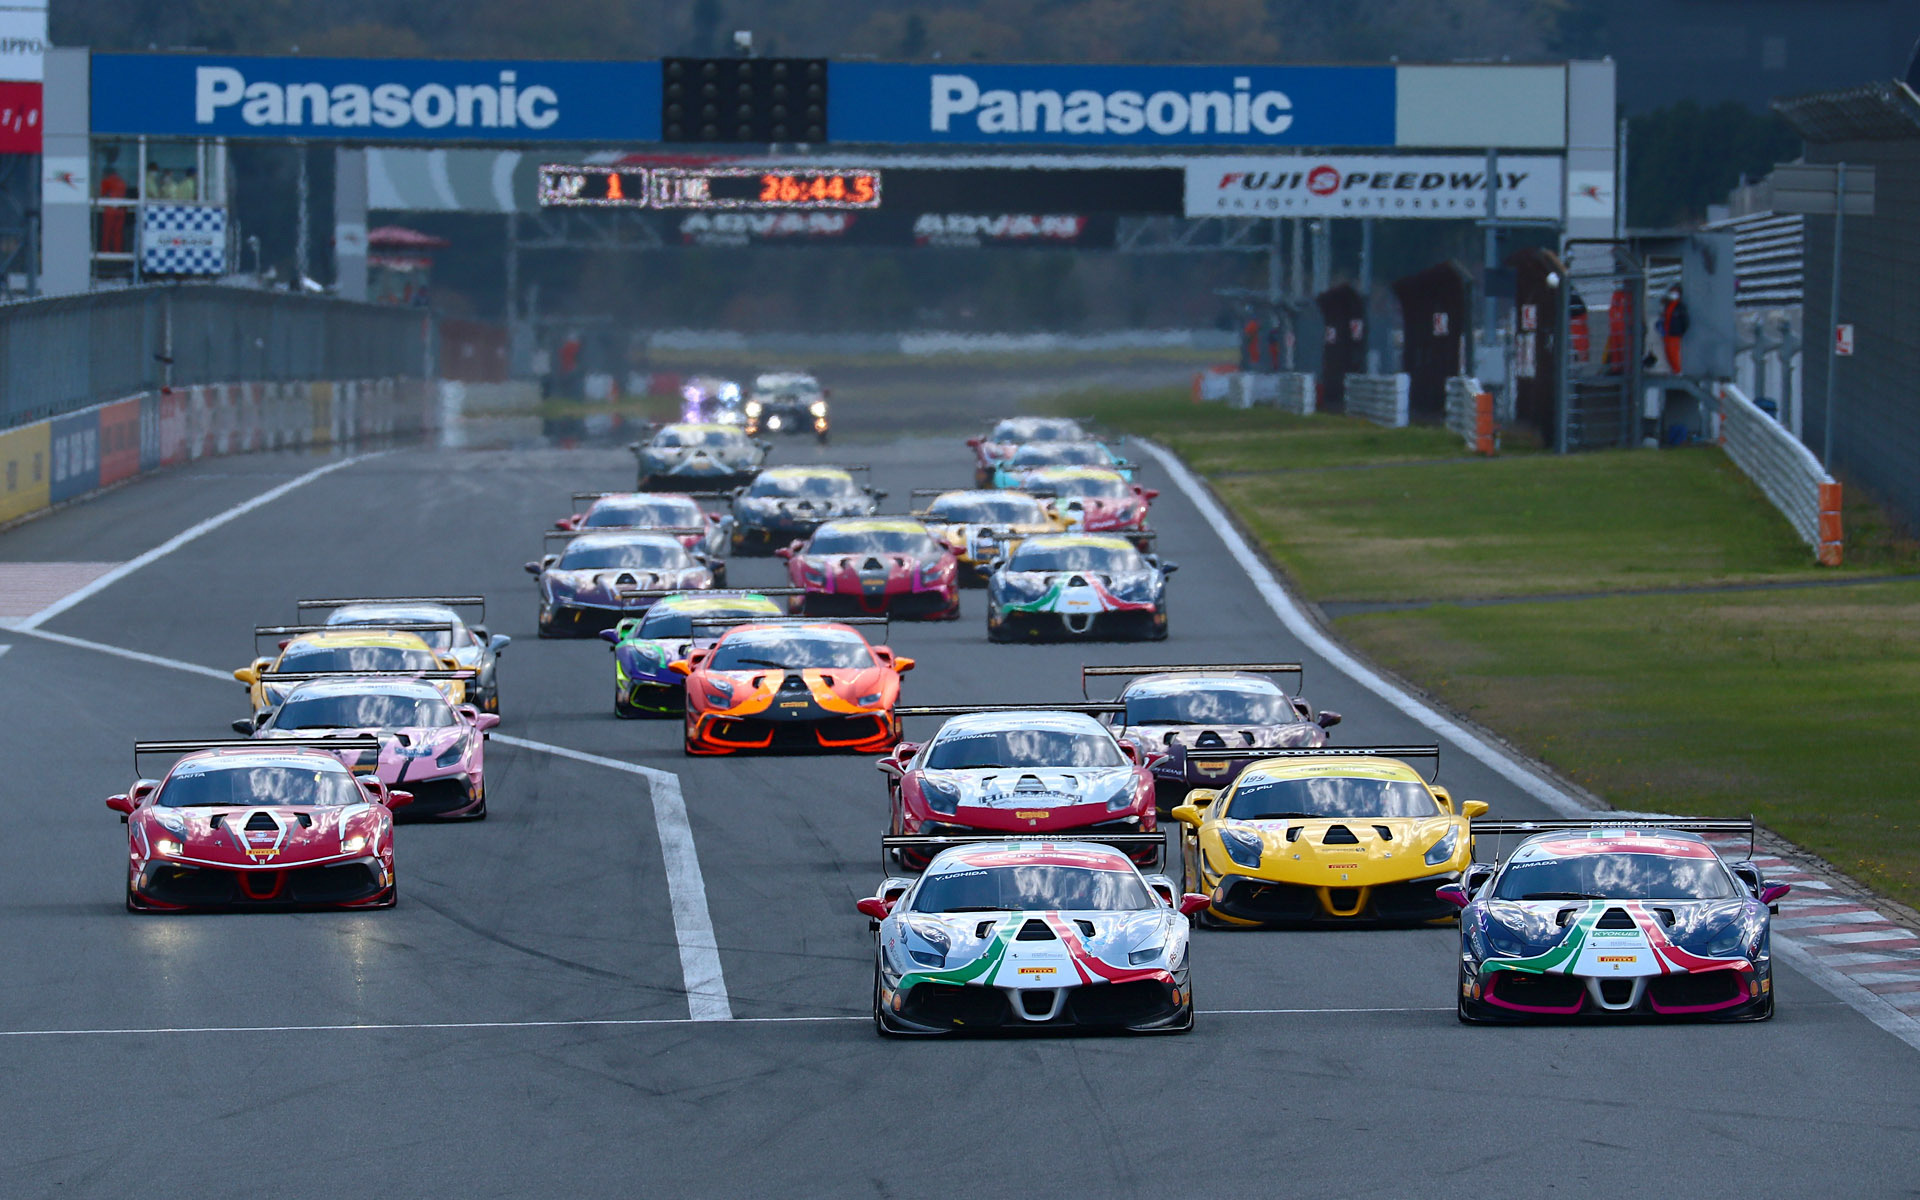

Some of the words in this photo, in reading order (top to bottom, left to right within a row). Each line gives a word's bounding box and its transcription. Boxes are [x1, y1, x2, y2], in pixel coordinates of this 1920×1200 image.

[196, 66, 559, 129] Panasonic
[930, 74, 1293, 135] Panasonic
[544, 173, 586, 198] LAP
[607, 172, 623, 199] 1
[1218, 171, 1304, 190] FUJI
[934, 870, 988, 882] Y.UCHIDA
[1511, 860, 1558, 871] N.IMADA
